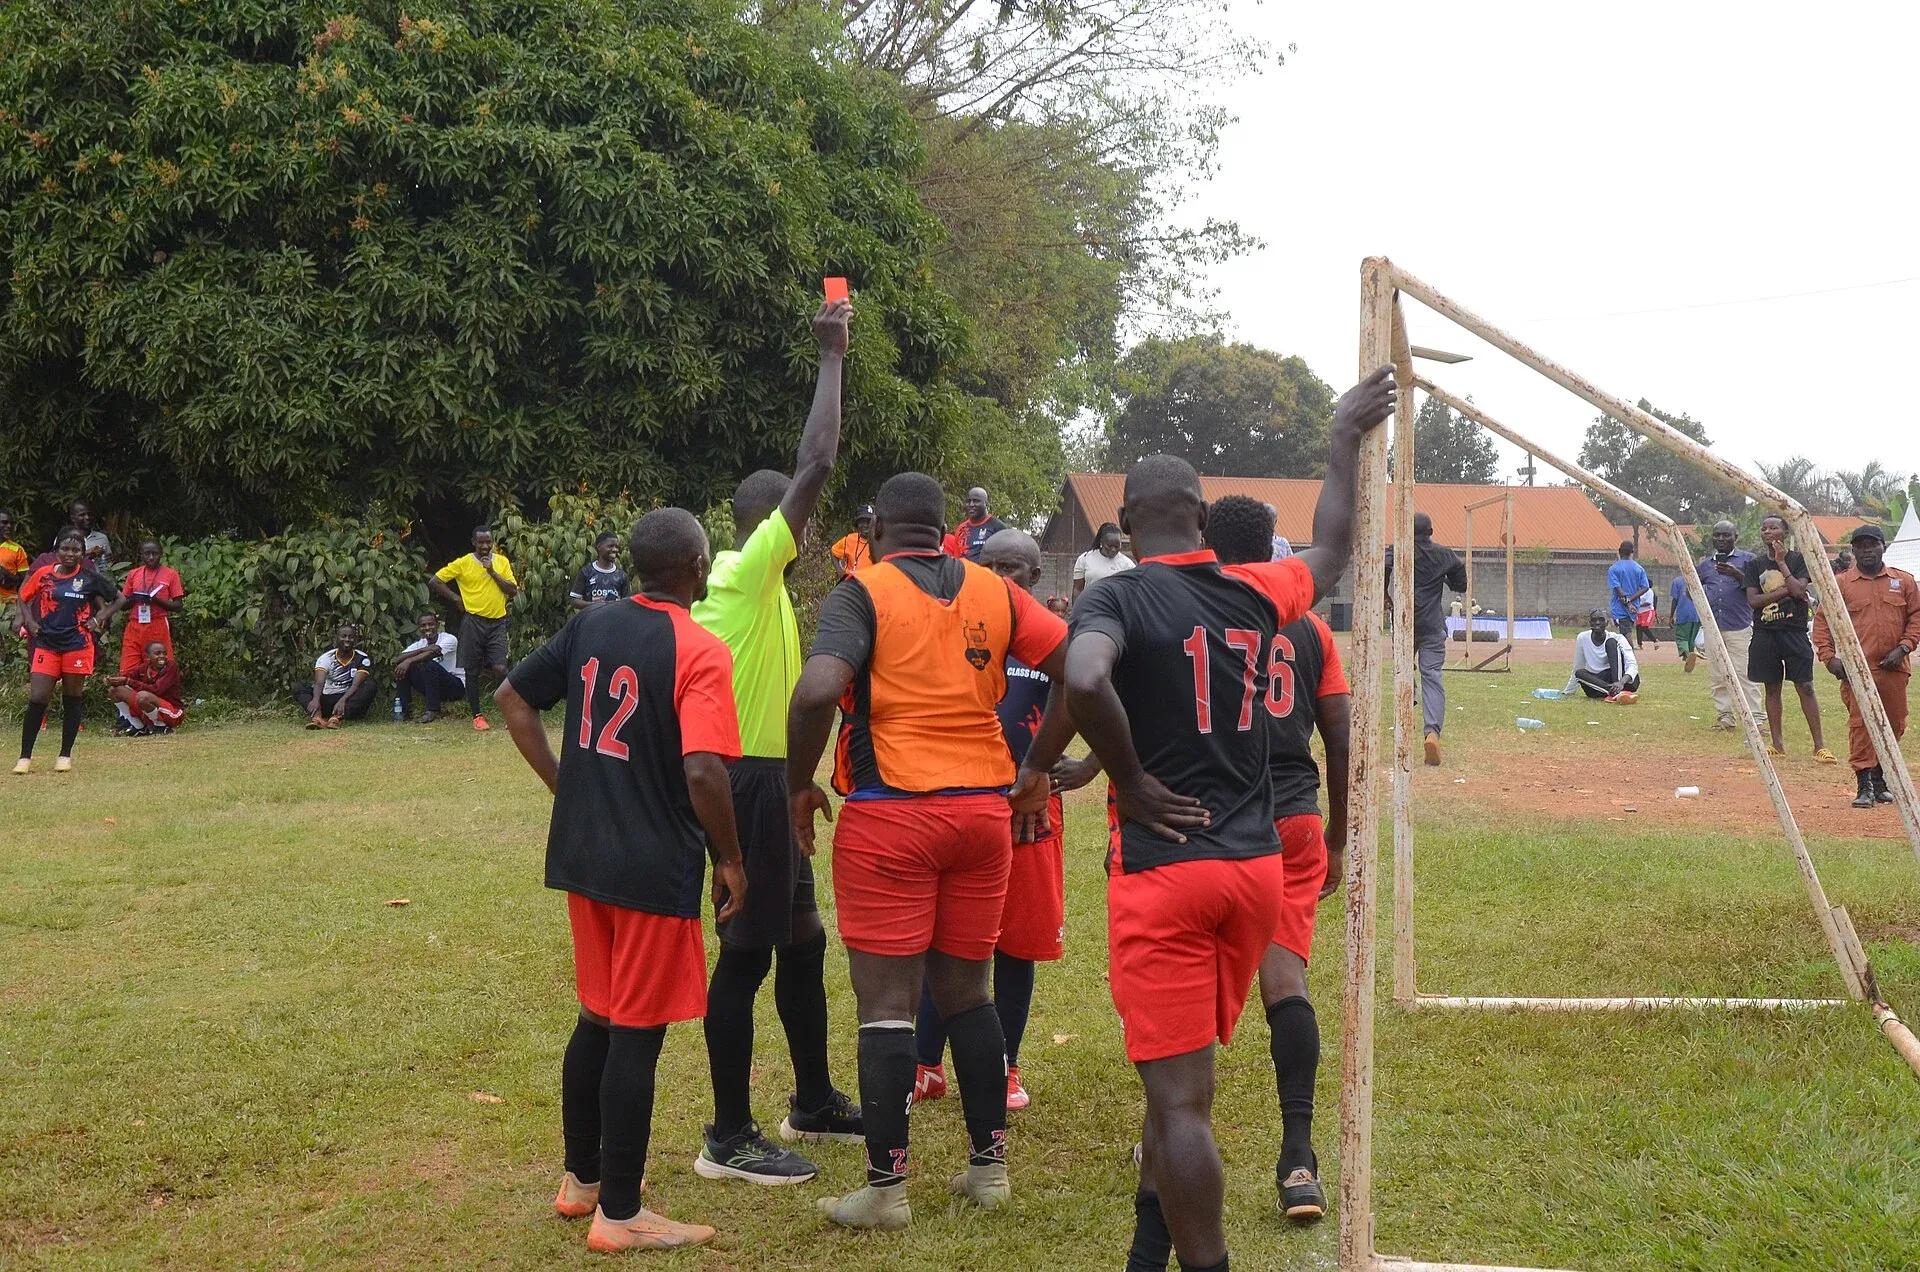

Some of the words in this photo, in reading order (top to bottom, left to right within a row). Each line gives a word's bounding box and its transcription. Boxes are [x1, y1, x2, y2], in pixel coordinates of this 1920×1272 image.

[38, 655, 45, 664] 5
[1006, 667, 1030, 678] CLASS
[1030, 669, 1040, 680] OF
[1183, 625, 1262, 734] 17
[1264, 633, 1296, 718] 6
[579, 656, 639, 761] 12
